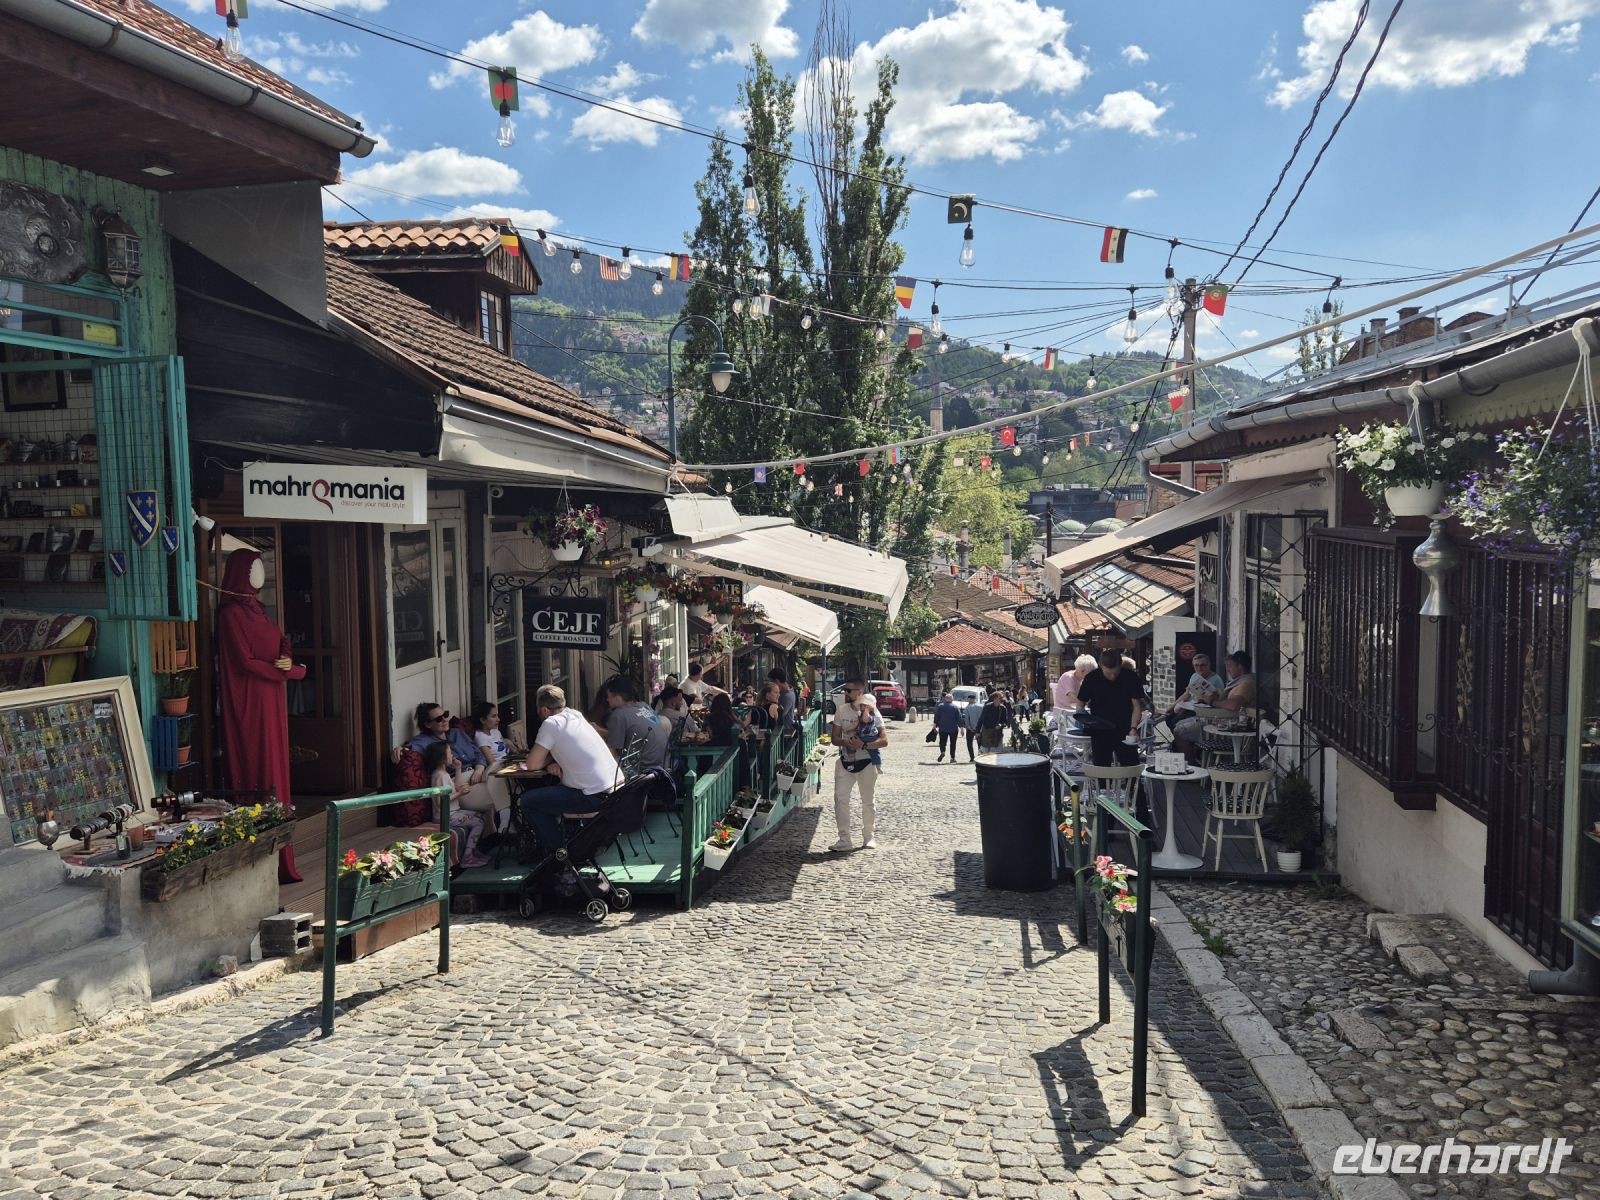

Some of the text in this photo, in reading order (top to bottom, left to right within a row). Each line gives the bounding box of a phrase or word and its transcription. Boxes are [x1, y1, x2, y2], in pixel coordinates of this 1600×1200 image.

[249, 475, 404, 512] mahromania
[532, 606, 601, 634] ĆEJF
[535, 633, 599, 643] COFFEE ROASTERS
